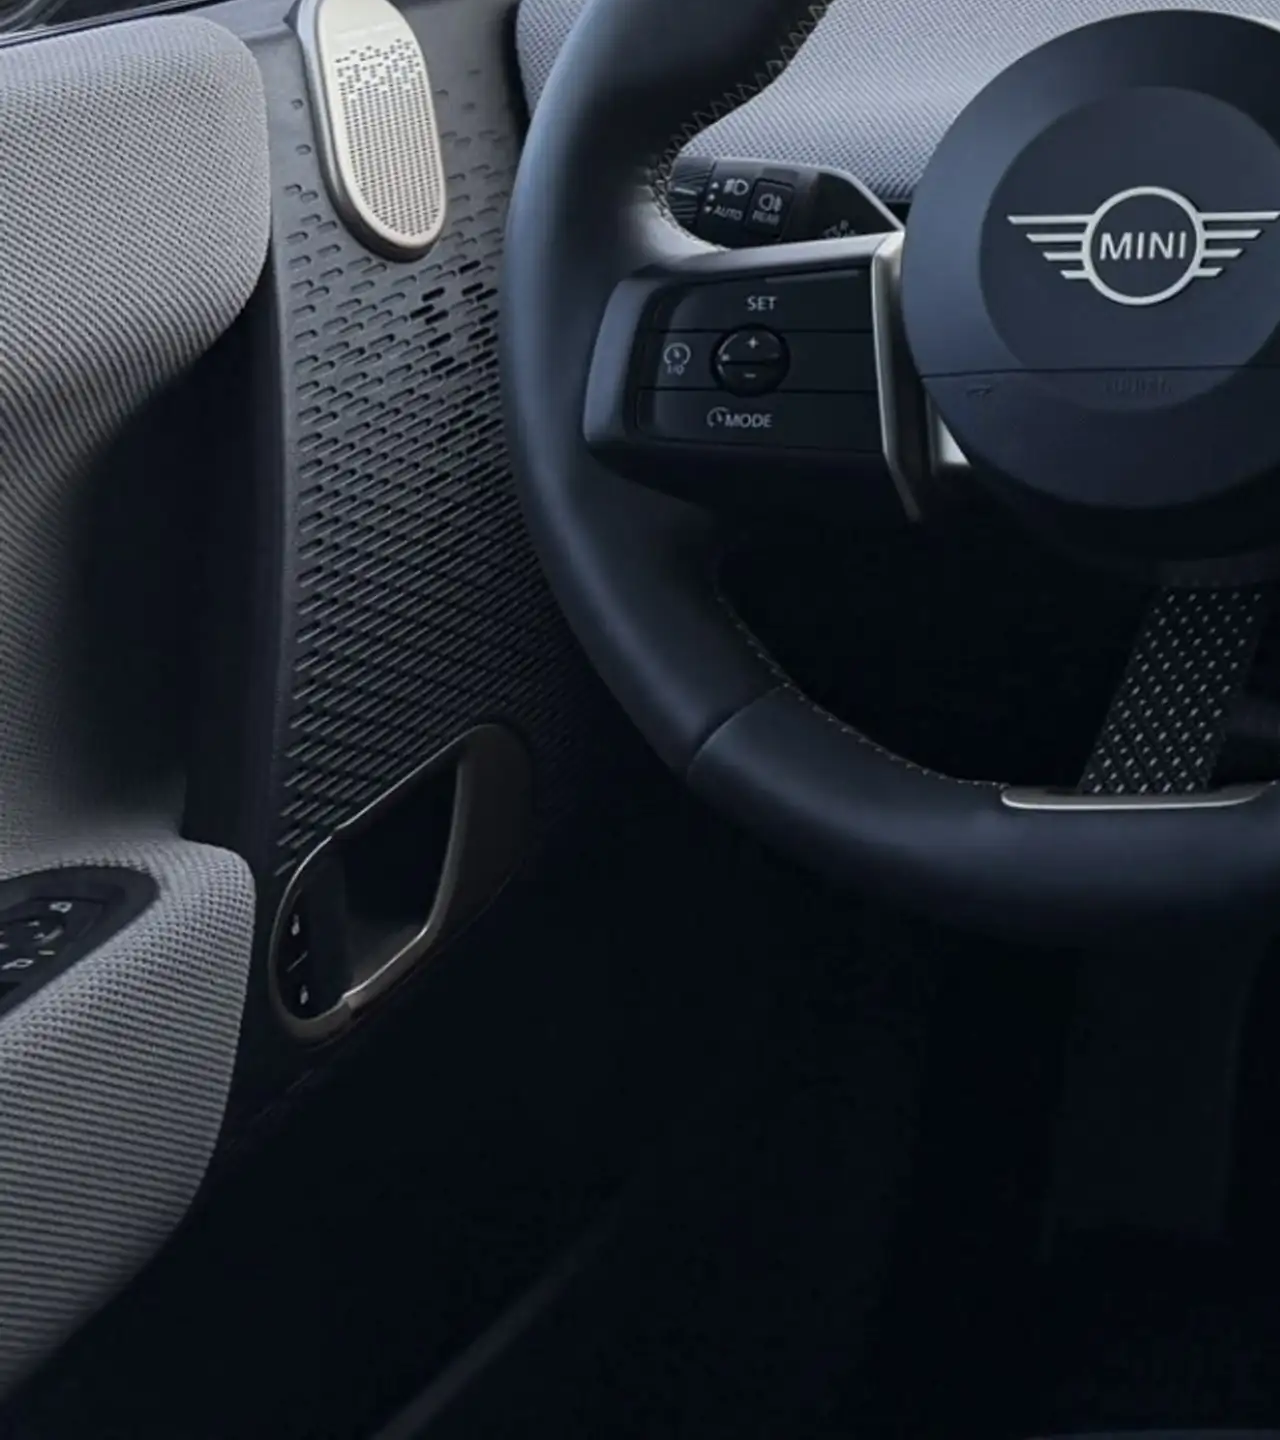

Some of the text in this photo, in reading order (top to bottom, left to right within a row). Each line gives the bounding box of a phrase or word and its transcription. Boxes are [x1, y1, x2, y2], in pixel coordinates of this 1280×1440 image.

[1099, 230, 1189, 261] MINI
[746, 295, 778, 312] SET
[724, 413, 773, 429] MODE
